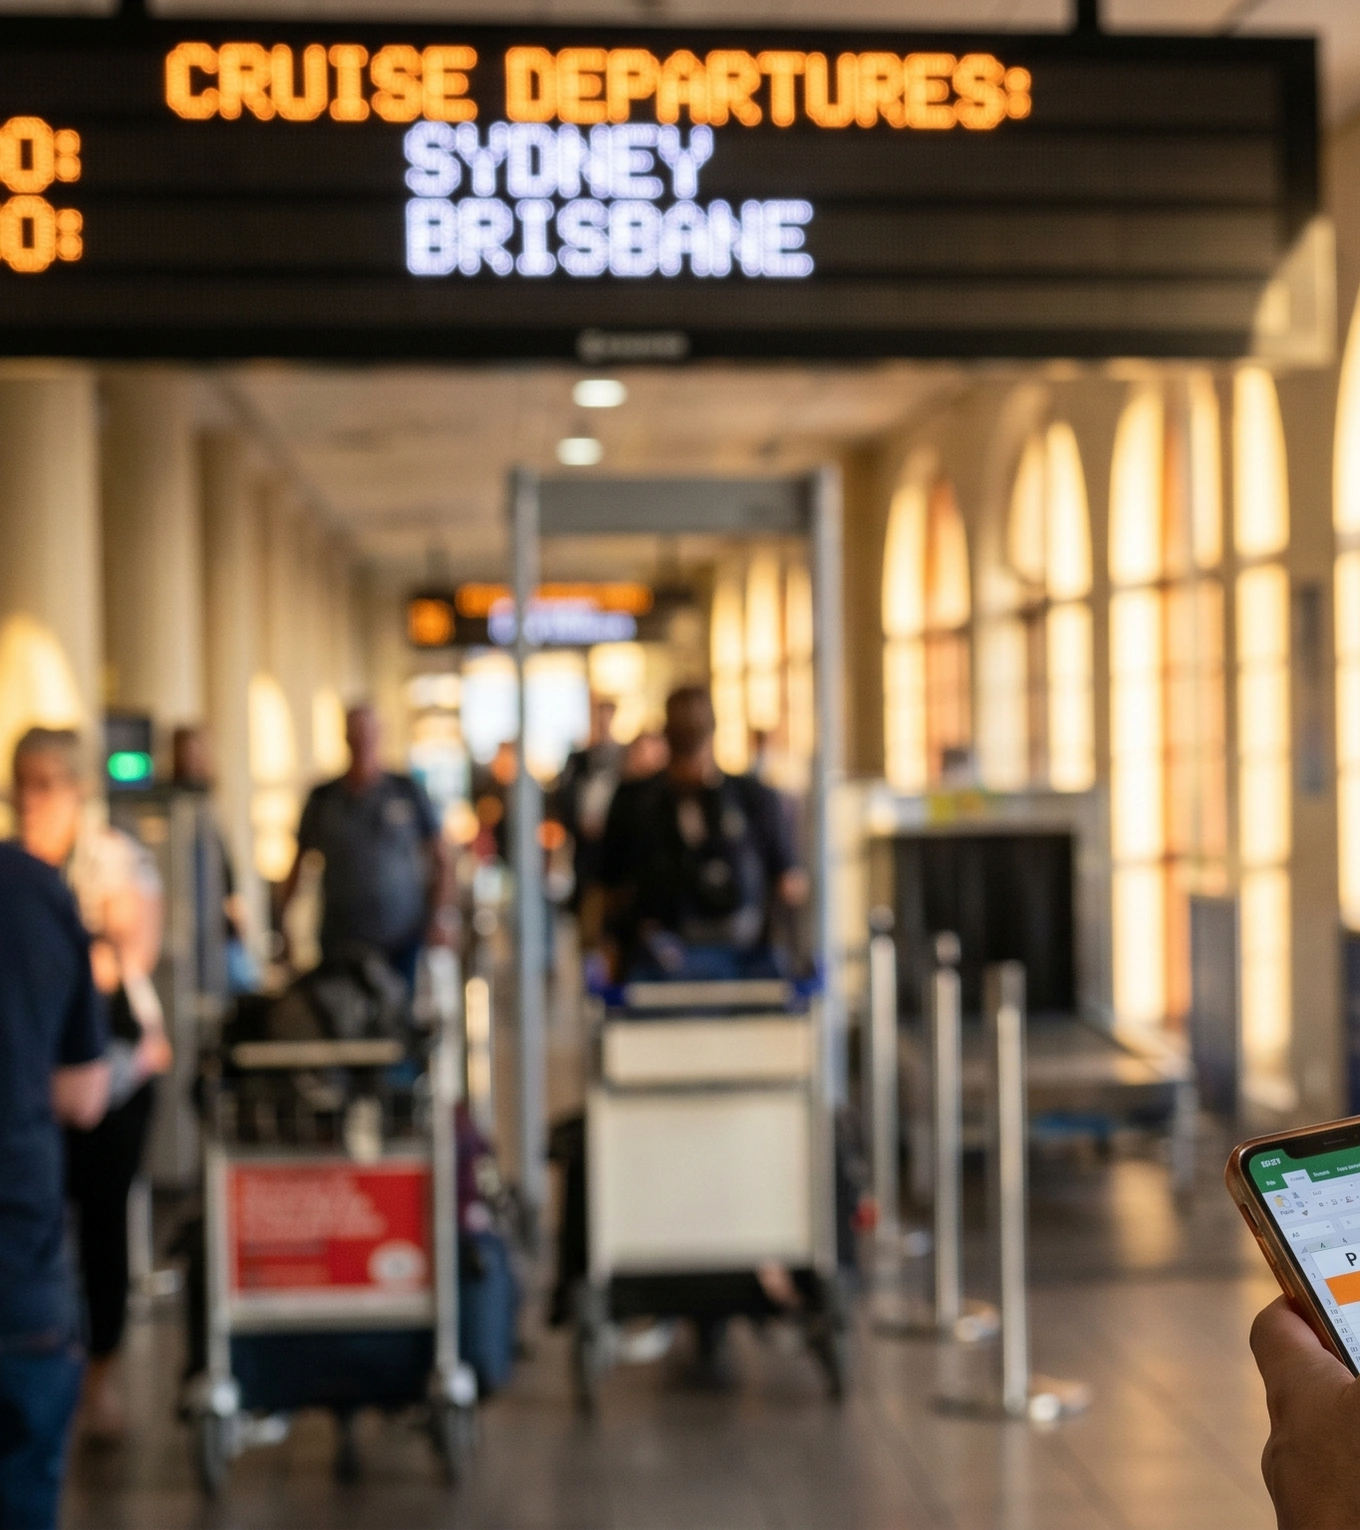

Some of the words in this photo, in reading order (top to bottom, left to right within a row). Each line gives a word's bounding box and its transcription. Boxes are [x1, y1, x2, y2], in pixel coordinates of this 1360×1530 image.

[165, 43, 478, 122] CRUISE
[505, 47, 1032, 130] DEPARTURES:
[403, 121, 714, 199] SYDNEY
[405, 200, 814, 277] BRISBANE
